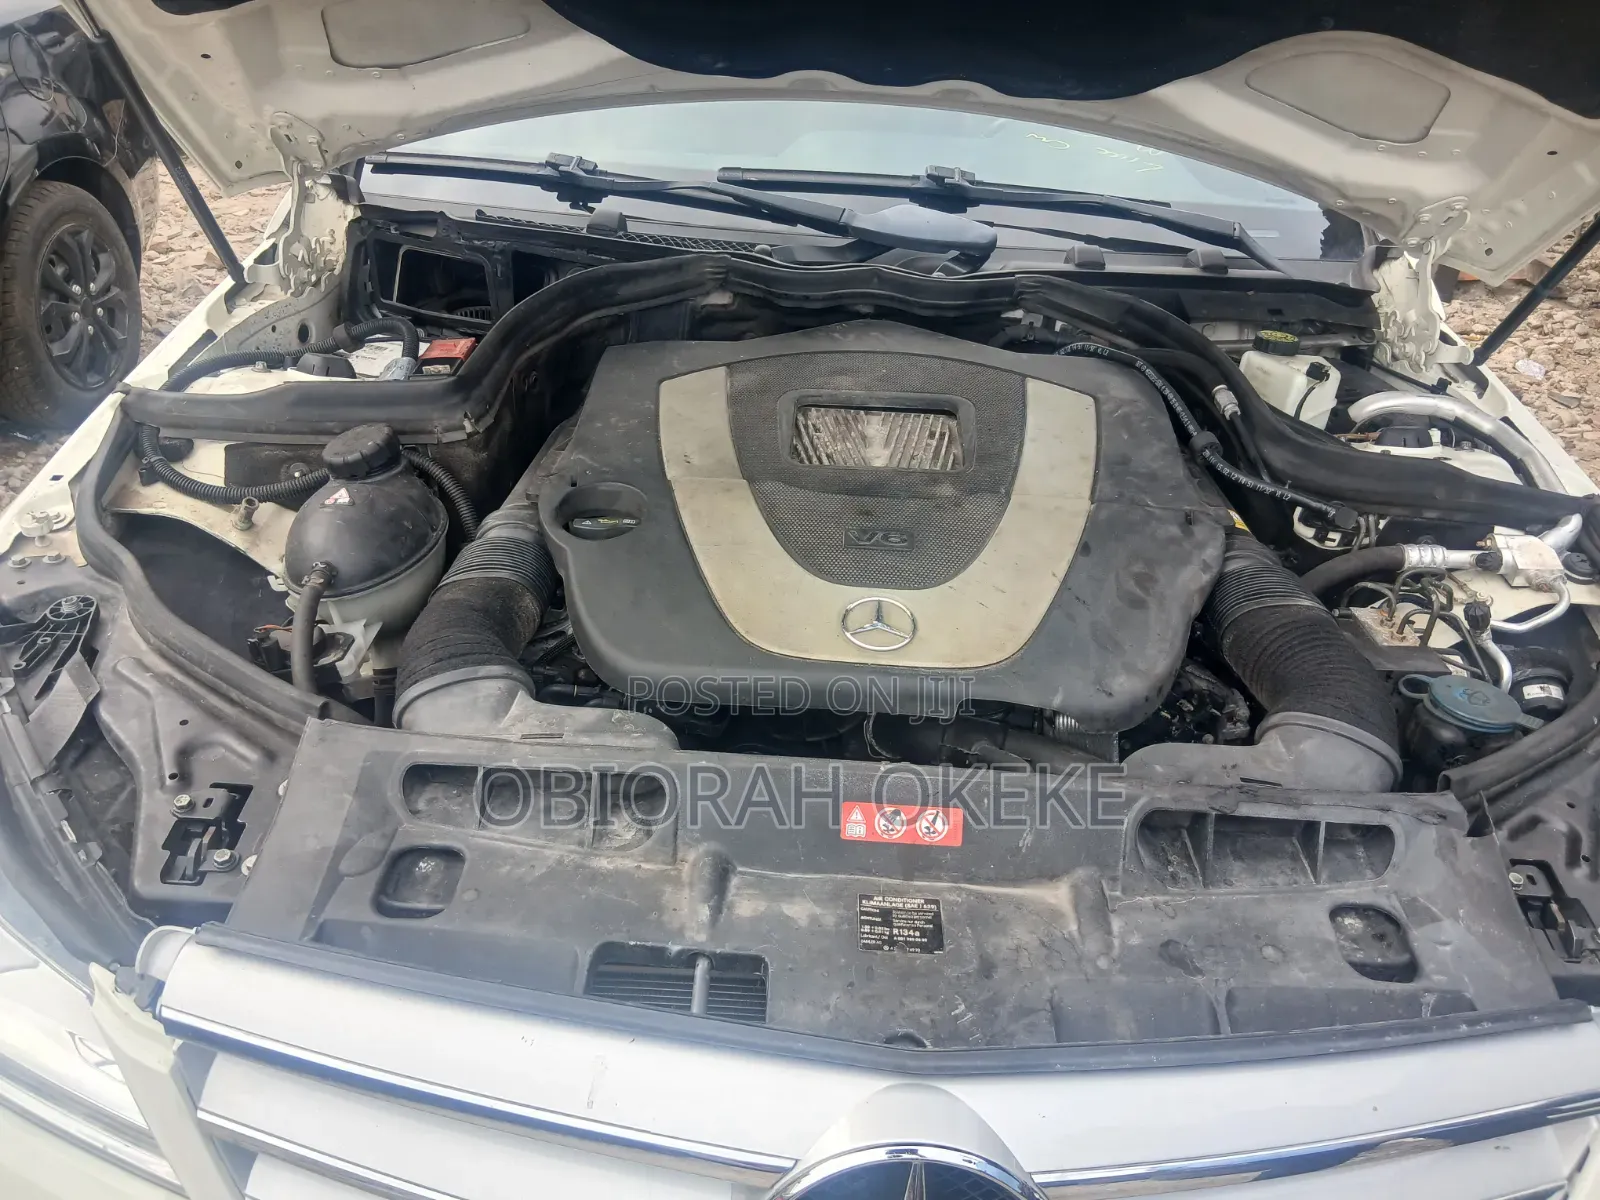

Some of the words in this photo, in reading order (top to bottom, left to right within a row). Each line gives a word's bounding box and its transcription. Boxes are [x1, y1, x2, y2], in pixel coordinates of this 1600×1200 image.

[847, 529, 909, 546] V6
[861, 900, 904, 908] KLIMAANLAGE
[884, 896, 925, 904] CONDITIONER
[893, 928, 920, 937] R134a
